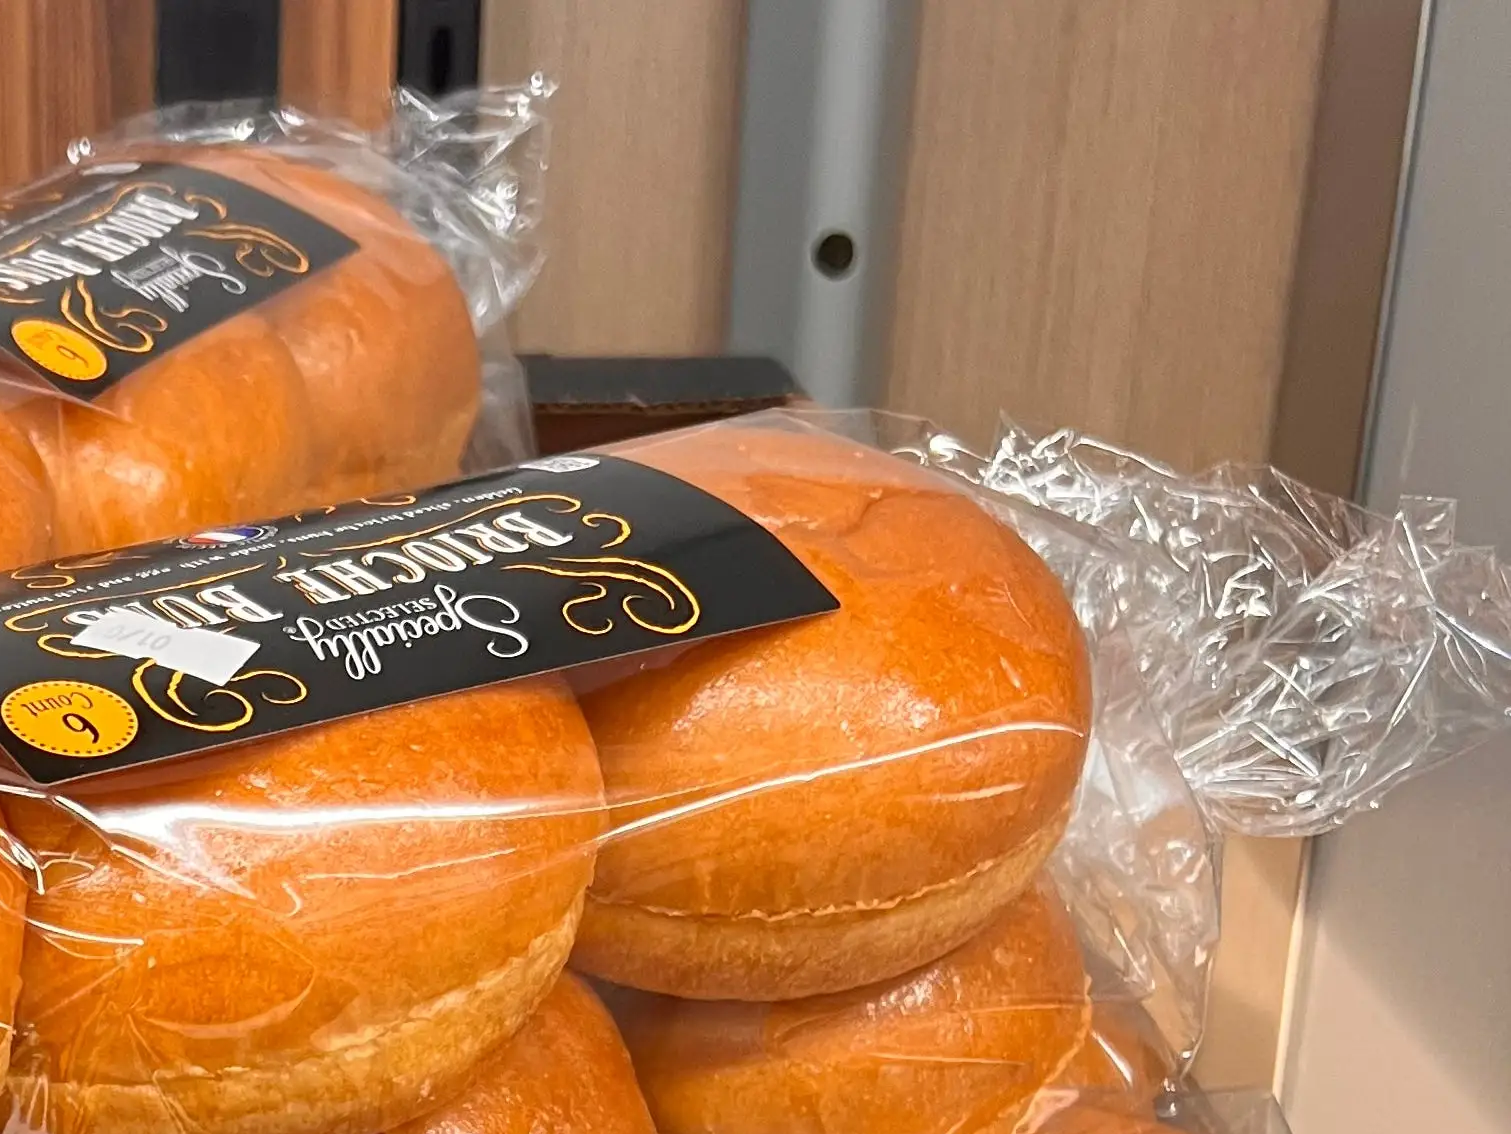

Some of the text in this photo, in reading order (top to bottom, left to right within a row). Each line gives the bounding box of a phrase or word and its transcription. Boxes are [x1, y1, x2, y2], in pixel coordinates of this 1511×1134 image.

[272, 511, 574, 606] BRIOCHE
[325, 597, 438, 631] SELECTED
[289, 584, 529, 681] Specially
[20, 690, 95, 718] Count
[61, 712, 101, 745] 6
